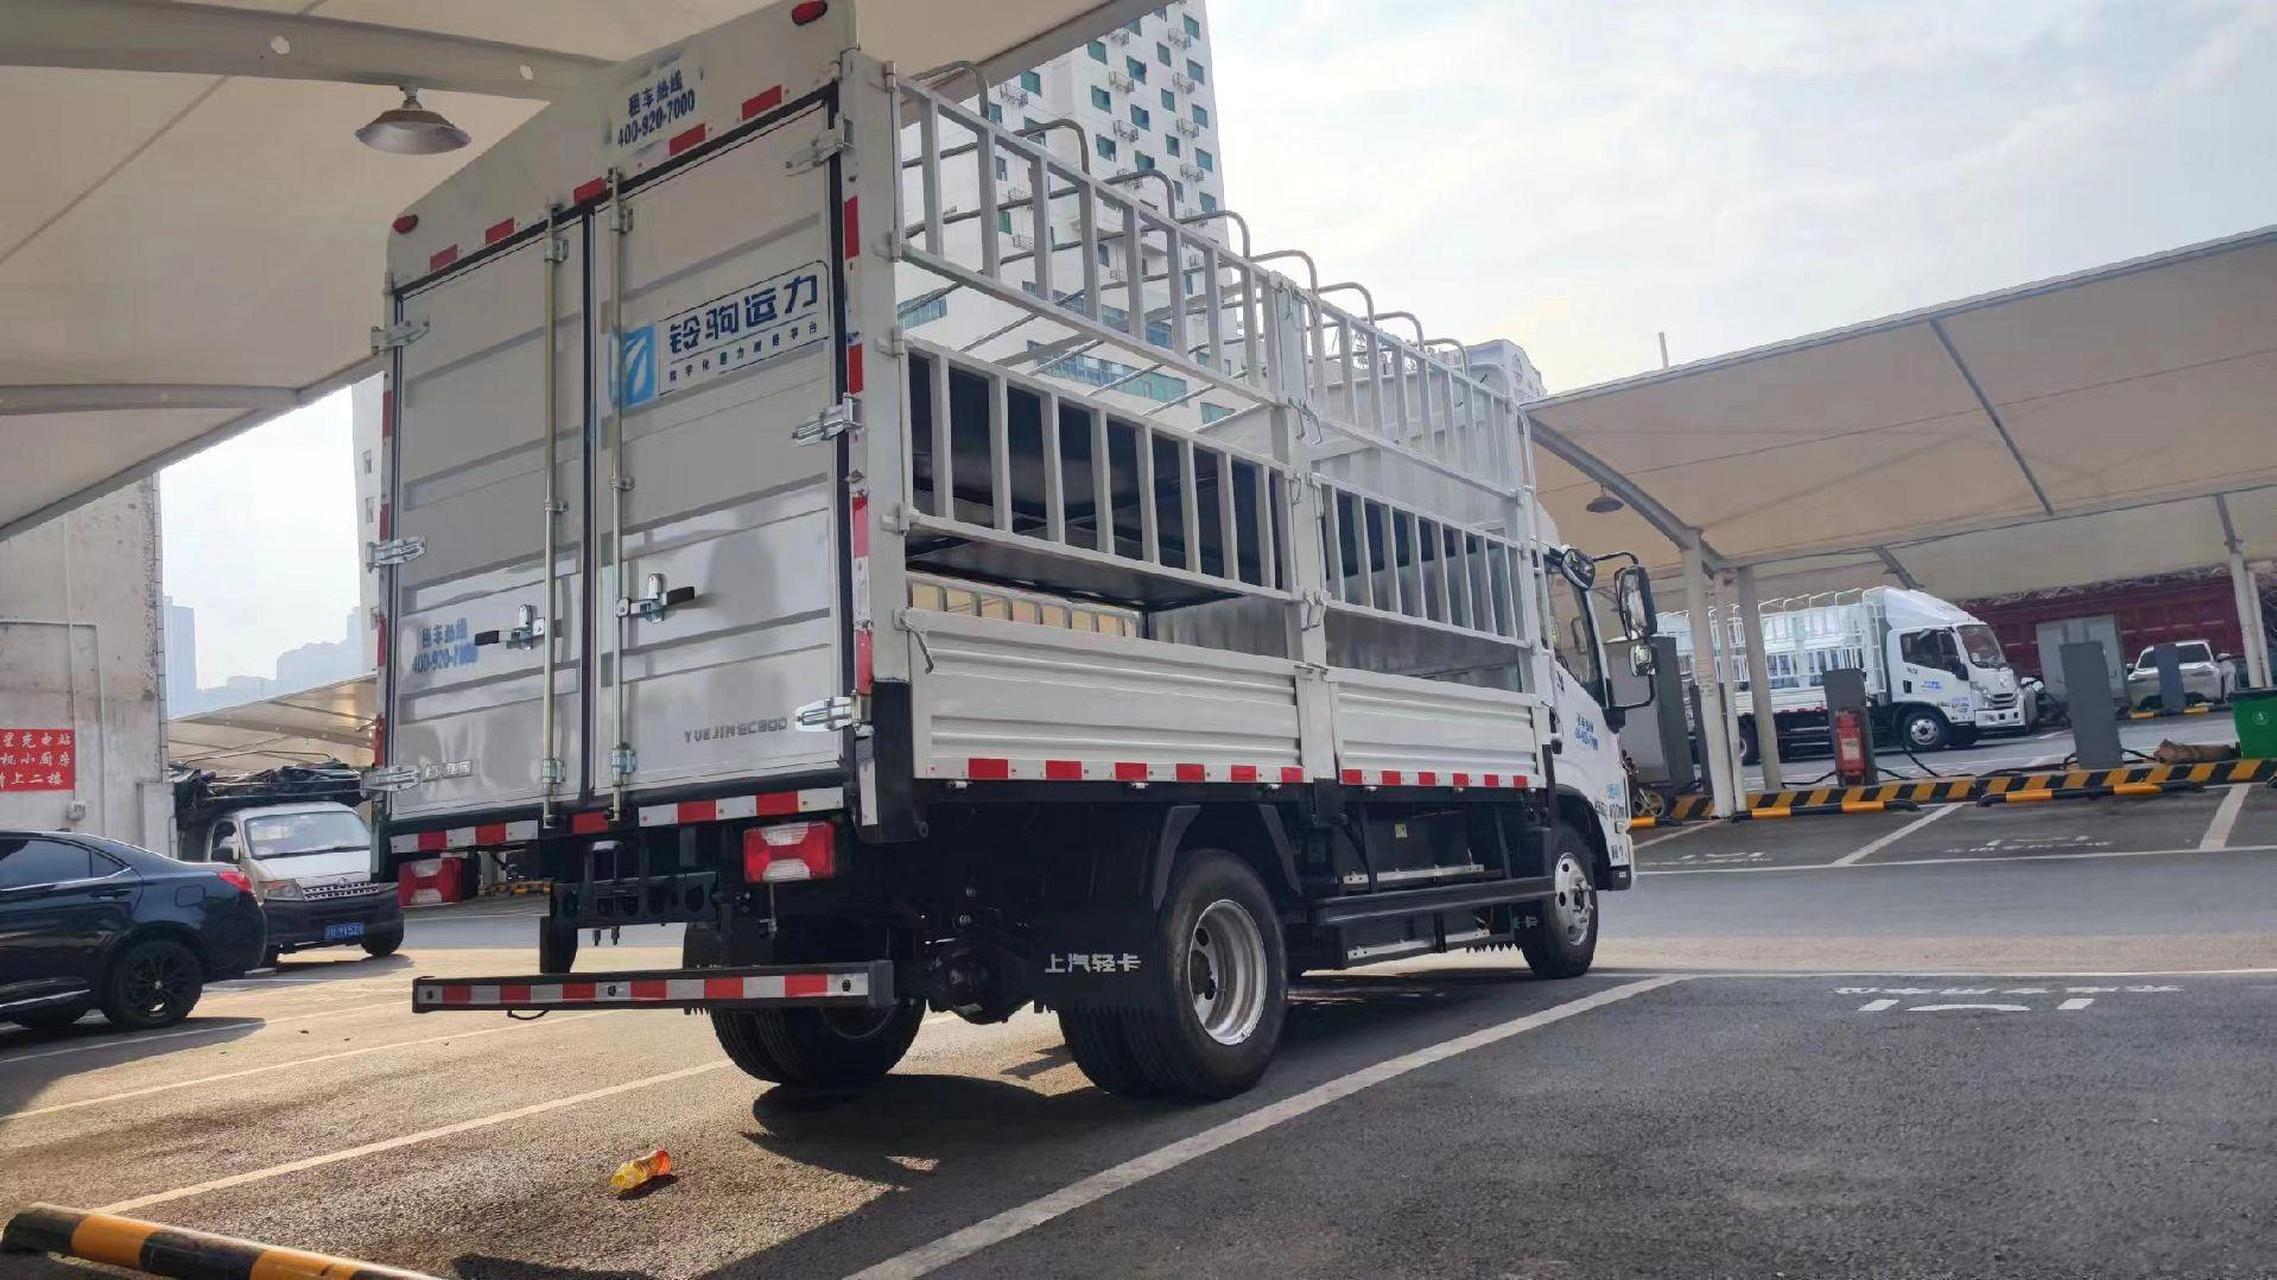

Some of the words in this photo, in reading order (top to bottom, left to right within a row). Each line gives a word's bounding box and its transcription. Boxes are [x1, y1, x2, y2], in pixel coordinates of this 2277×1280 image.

[618, 88, 695, 148] 400-920-7000
[669, 274, 818, 354] 铃驹运力
[1044, 953, 1142, 973] 上汽轻卡
